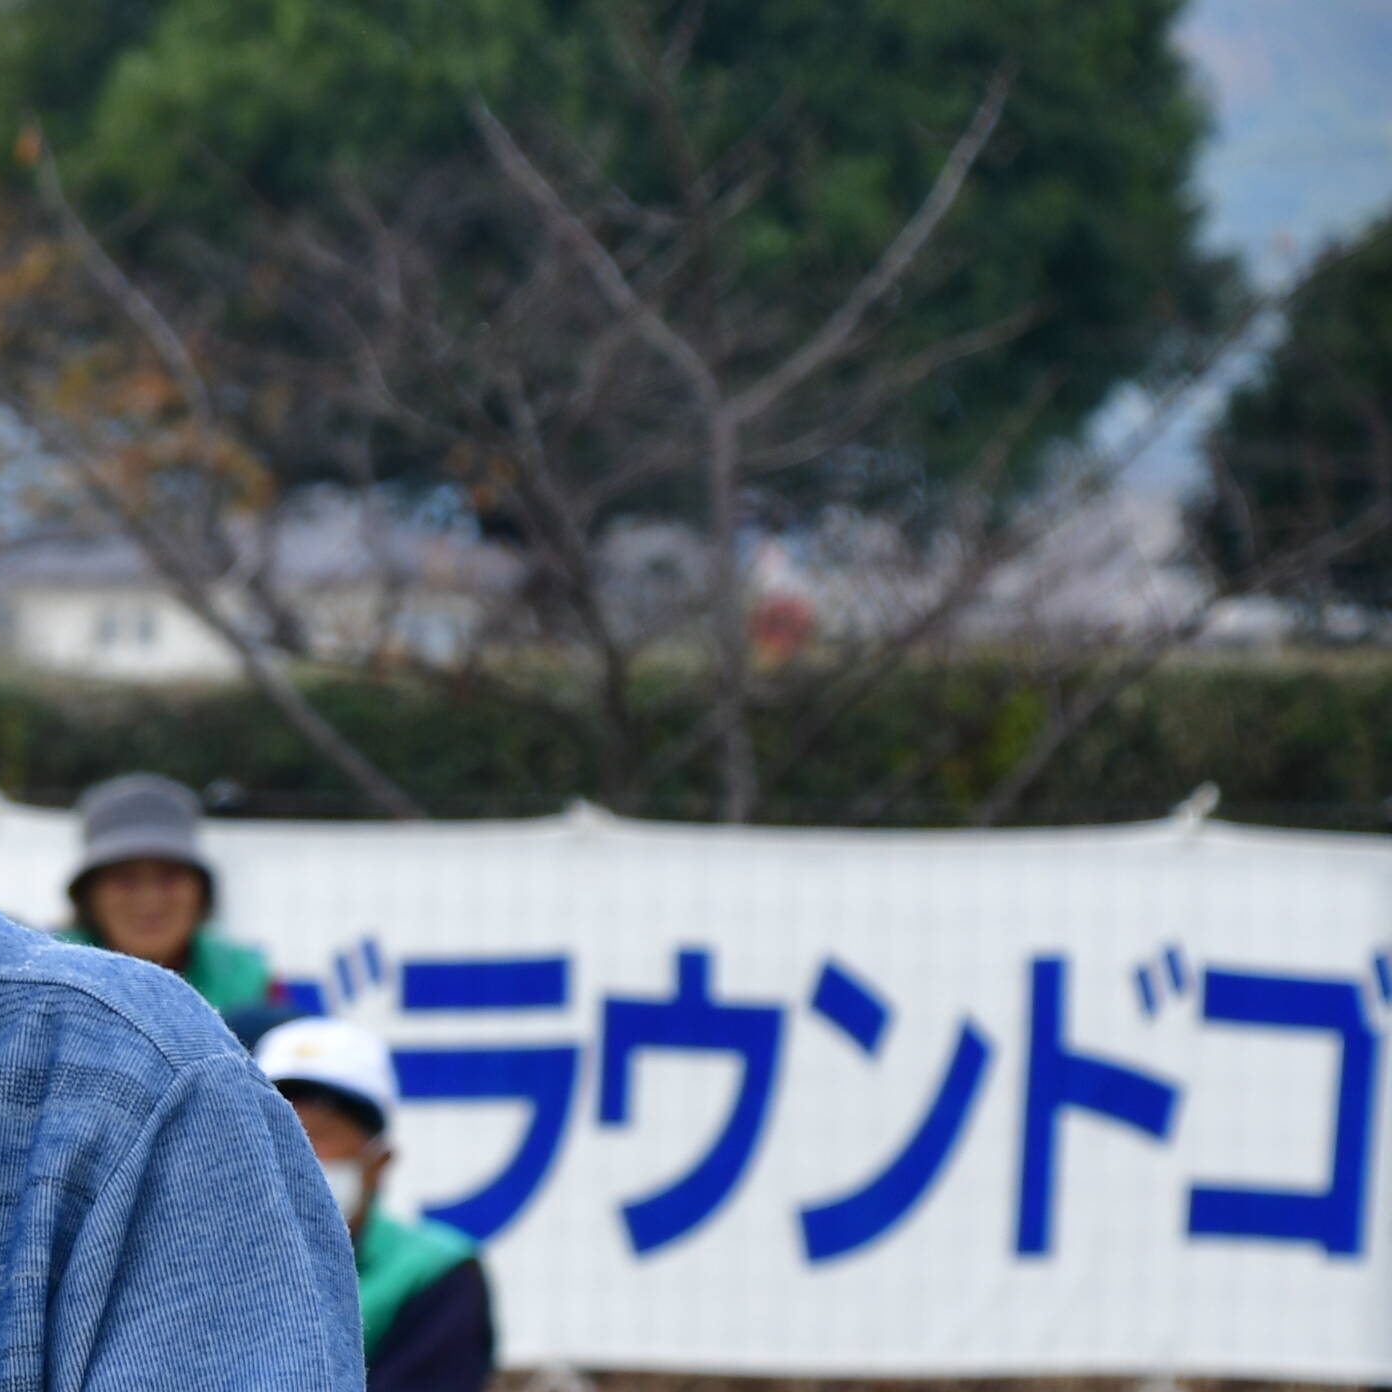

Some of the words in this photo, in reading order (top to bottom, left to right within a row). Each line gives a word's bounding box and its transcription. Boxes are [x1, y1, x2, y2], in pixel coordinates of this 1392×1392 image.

[276, 937, 1392, 1264] ラウンドゴ
